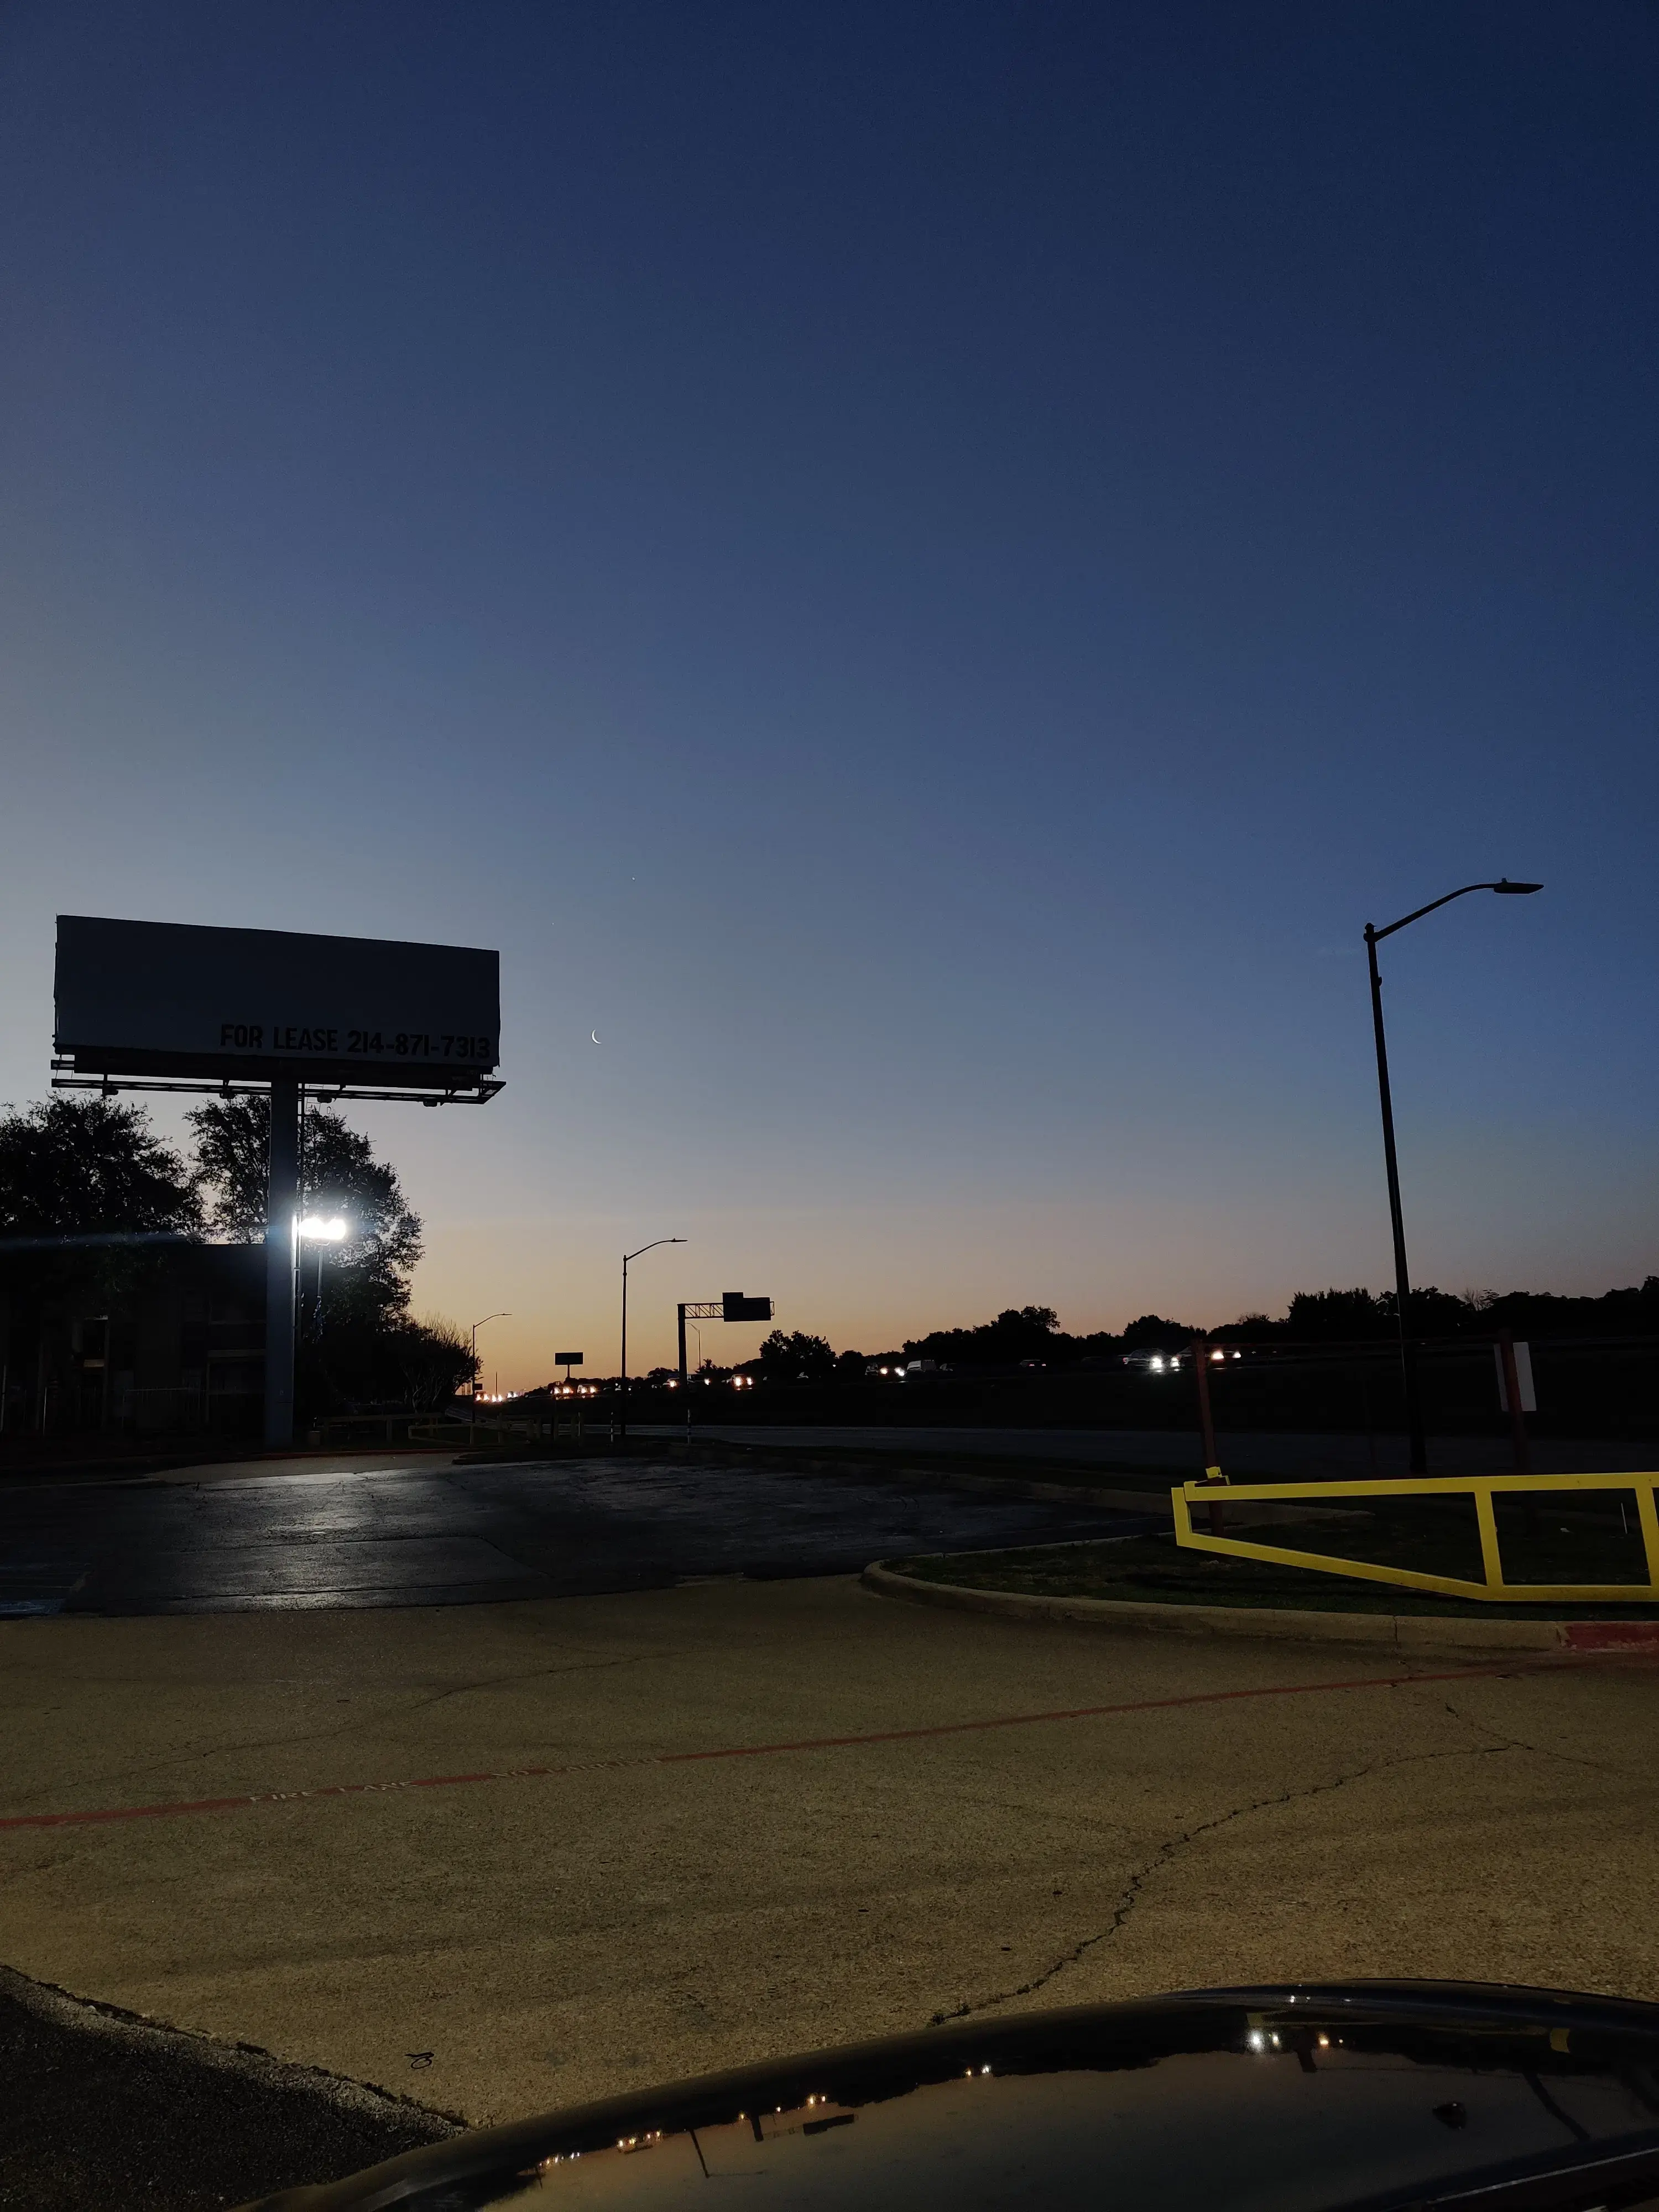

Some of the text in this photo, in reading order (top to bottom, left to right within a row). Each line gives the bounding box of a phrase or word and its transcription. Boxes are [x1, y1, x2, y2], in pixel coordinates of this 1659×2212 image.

[221, 1024, 491, 1058] FOR LEASE 214-871-7313
[249, 1790, 319, 1802] FIRE
[338, 1781, 418, 1792] LANE
